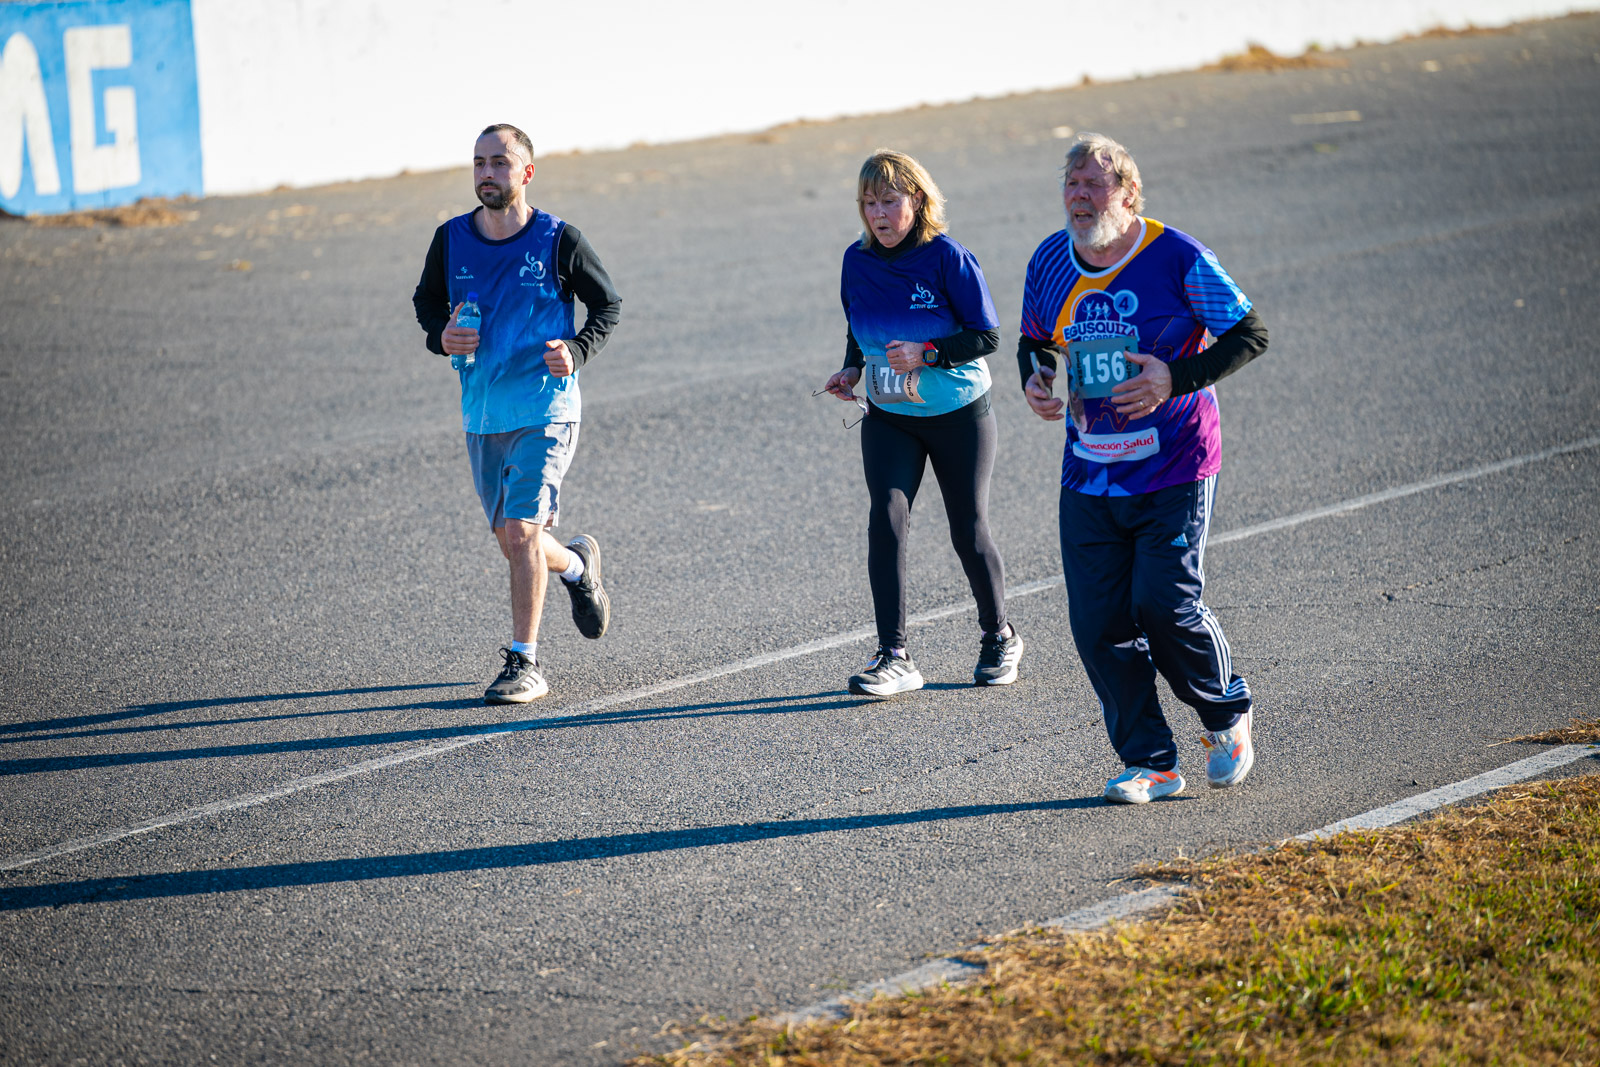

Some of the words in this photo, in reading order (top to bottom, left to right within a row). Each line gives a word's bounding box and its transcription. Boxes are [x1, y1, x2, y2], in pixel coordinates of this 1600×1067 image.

[1118, 296, 1129, 311] 4
[1063, 322, 1136, 341] EGUSQUIZA
[871, 364, 880, 396] TIEMPO
[880, 367, 902, 394] 77
[1075, 351, 1084, 387] TIEMPO
[1082, 350, 1126, 385] 156
[906, 371, 914, 397] XACTO
[1123, 434, 1155, 450] Salud
